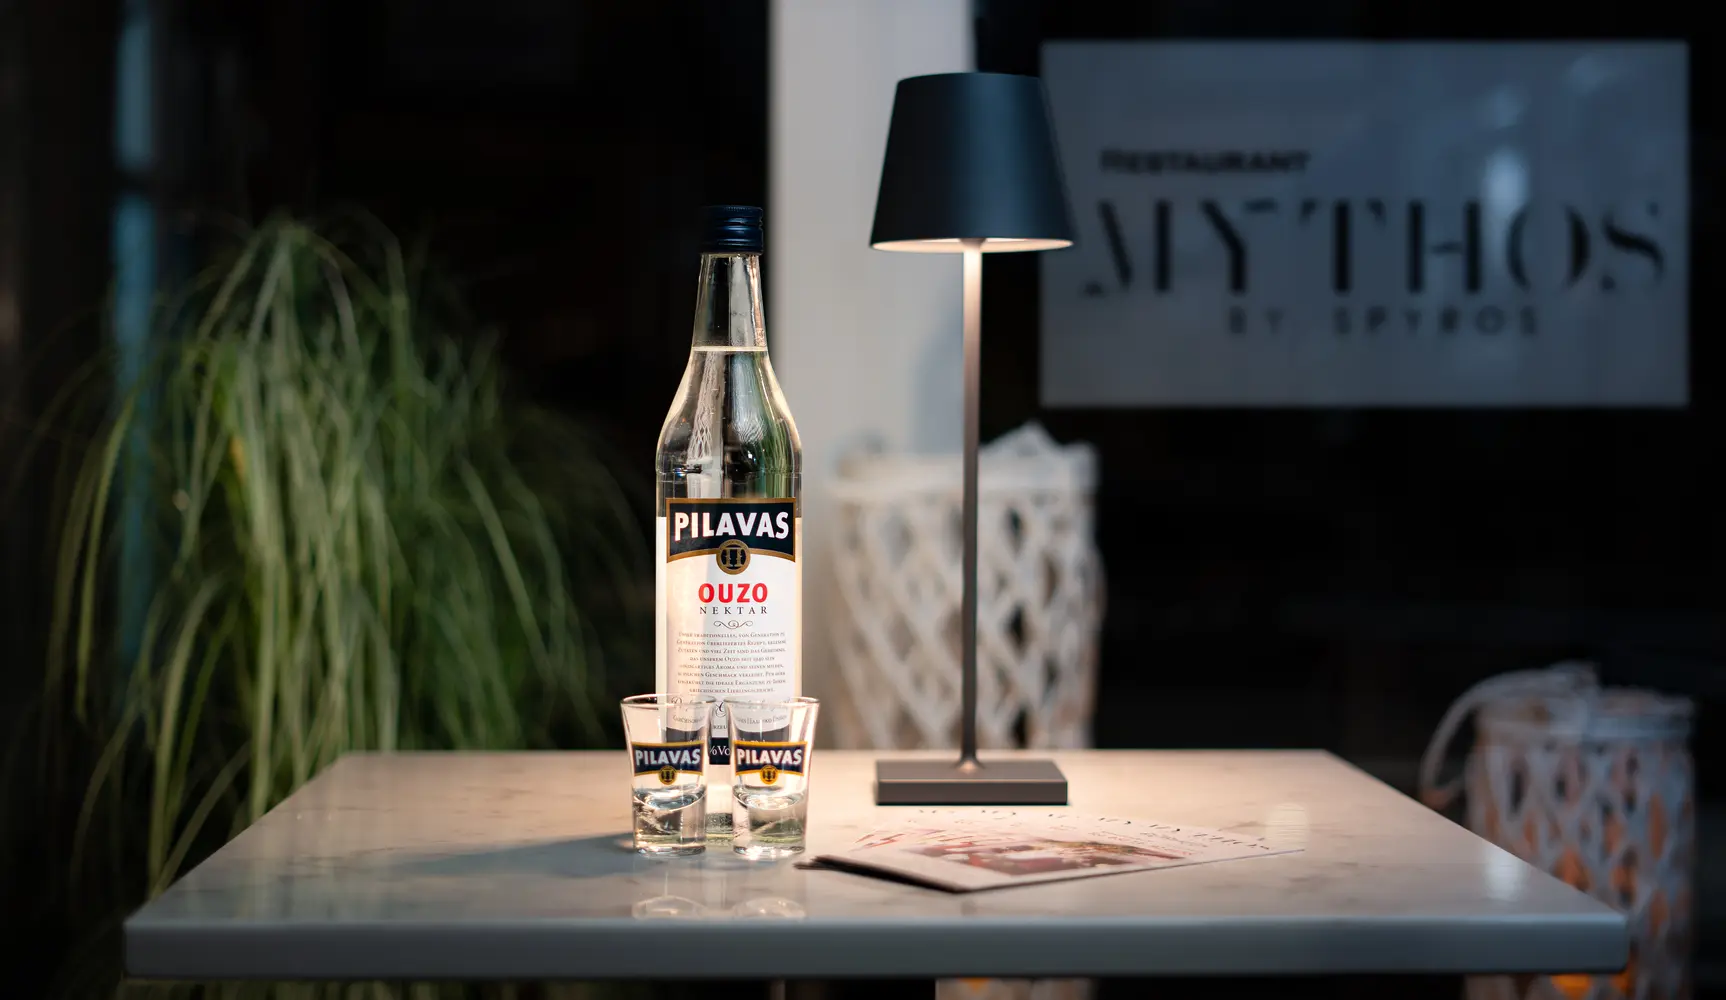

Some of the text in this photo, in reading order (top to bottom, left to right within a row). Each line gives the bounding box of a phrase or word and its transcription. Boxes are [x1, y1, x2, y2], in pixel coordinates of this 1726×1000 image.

[1081, 198, 1665, 297] MYTHOS
[1229, 305, 1285, 335] BY
[674, 511, 789, 542] PILAVAS
[698, 582, 768, 604] OUZO
[699, 606, 768, 615] NEKTAR
[635, 748, 701, 766] PILAVAS
[737, 748, 803, 766] PILAVAS
